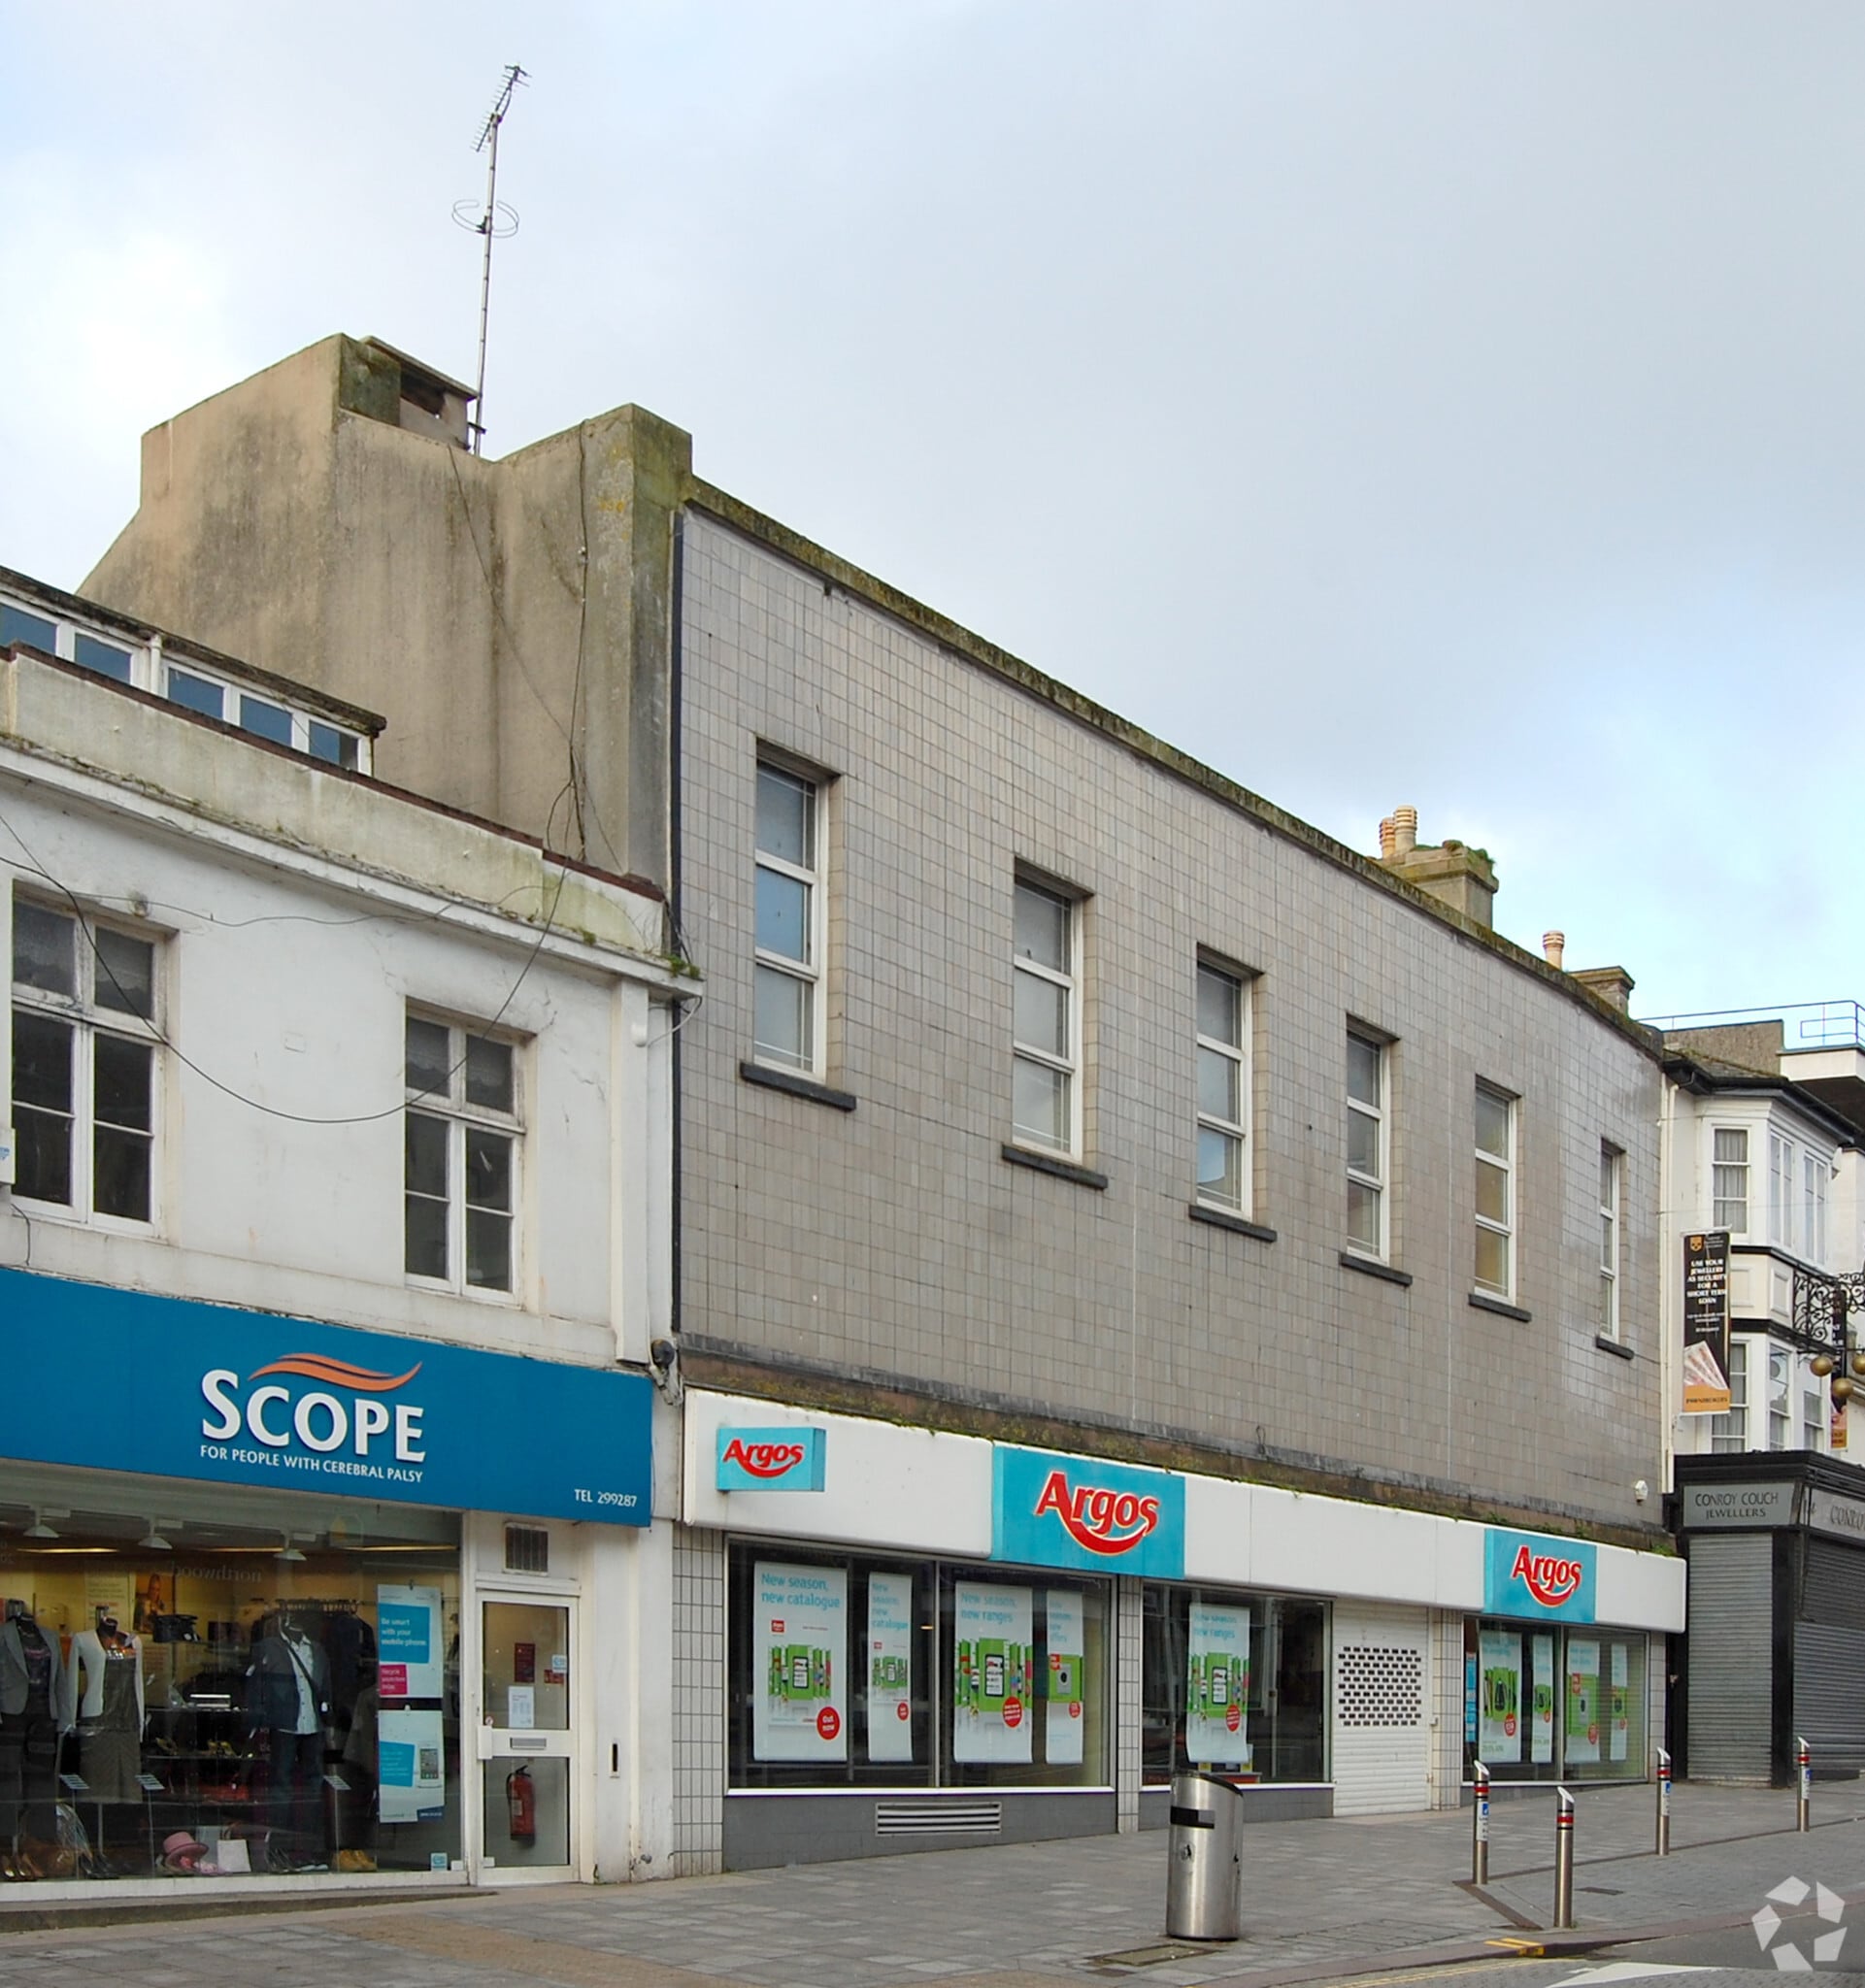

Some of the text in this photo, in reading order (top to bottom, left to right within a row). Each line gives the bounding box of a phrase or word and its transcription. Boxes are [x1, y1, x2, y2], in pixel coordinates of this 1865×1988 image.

[201, 1369, 426, 1463] SCOPE
[200, 1444, 423, 1483] FOR PEOPLE WITH CEREBRAL PALSY
[722, 1438, 805, 1478] Argos
[574, 1488, 638, 1508] TEL 299287
[1695, 1491, 1780, 1507] CONROY COUCH
[1034, 1470, 1161, 1556] Argos
[1706, 1507, 1767, 1520] JEWELLERS
[1830, 1506, 1865, 1531] CONRO
[761, 1573, 829, 1591] New season,
[1511, 1544, 1583, 1607] Argos
[761, 1592, 841, 1610] new catalogue
